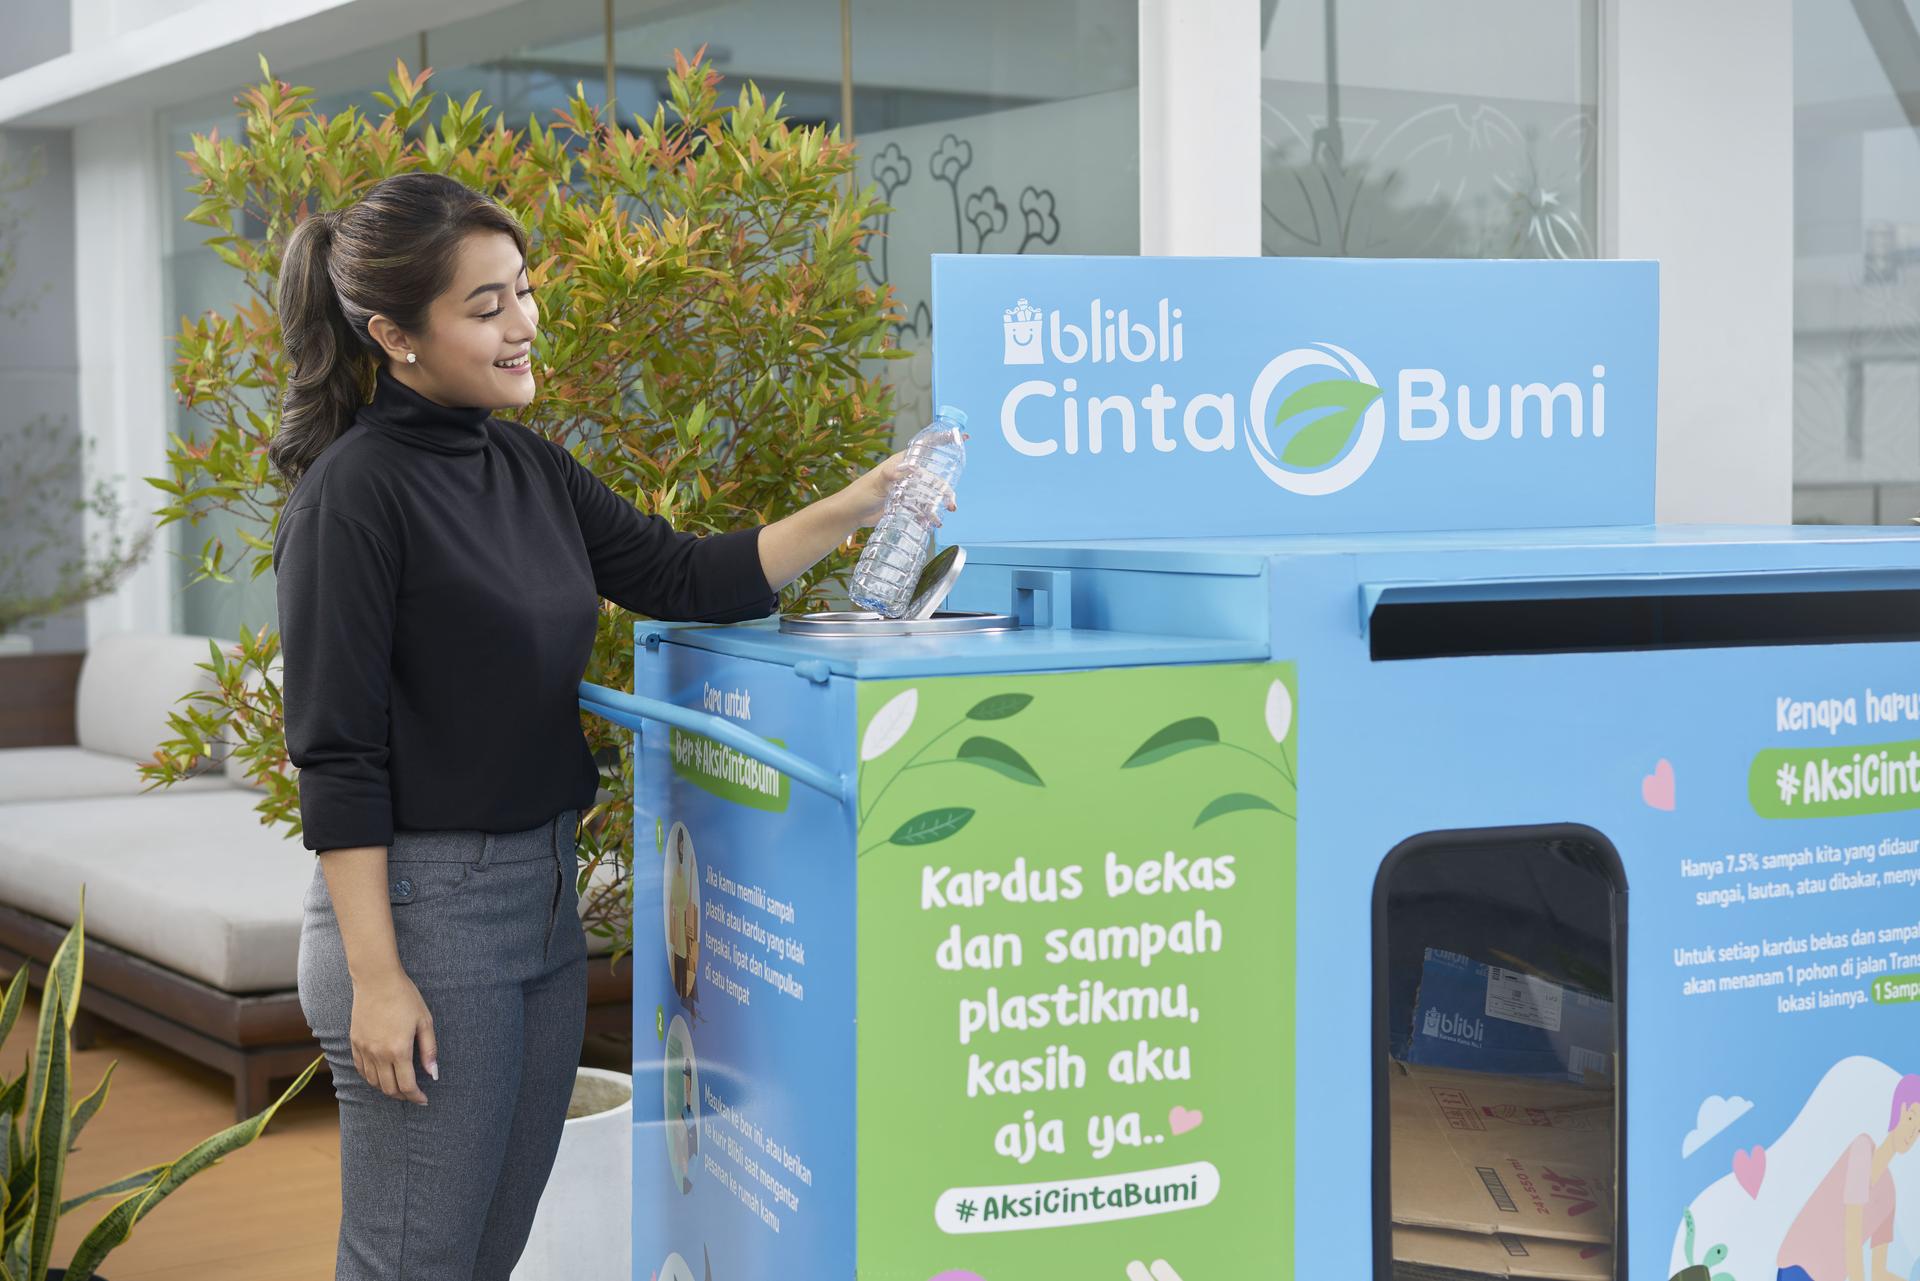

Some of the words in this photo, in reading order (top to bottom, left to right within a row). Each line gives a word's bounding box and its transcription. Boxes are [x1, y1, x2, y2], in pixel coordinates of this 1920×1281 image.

[1050, 297, 1183, 364] blibli
[1000, 378, 1235, 456] Cinta
[1398, 364, 1606, 442] Bumi
[703, 681, 722, 715] Cara
[724, 687, 751, 721] untuk
[1776, 697, 1857, 735] Kenapa
[1865, 688, 1920, 724] haru
[921, 856, 1083, 910] Kardus
[1105, 851, 1236, 898] bekas
[1681, 858, 1724, 880] Hanya
[1726, 852, 1760, 873] 7.5%
[1762, 847, 1813, 871] sampah
[1816, 844, 1841, 863] kita
[1843, 843, 1875, 866] yang
[1878, 837, 1920, 857] didaur
[705, 864, 717, 887] Jika
[718, 870, 736, 896] kamu
[737, 884, 766, 910] memiliki
[767, 897, 795, 925] sampah
[1696, 882, 1745, 908] sungai,
[1747, 881, 1795, 901] lautan,
[1796, 877, 1826, 895] atau
[1829, 869, 1881, 891] dibakar,
[705, 898, 726, 925] plastik
[726, 911, 742, 933] atau
[742, 915, 766, 945] kardus
[767, 931, 784, 961] yang
[786, 937, 805, 966] tidak
[935, 924, 1022, 971] dan
[1045, 909, 1222, 967] sampah
[1674, 944, 1716, 967] Untuk
[1718, 941, 1760, 963] setiap
[1762, 935, 1808, 957] kardus
[1810, 932, 1849, 951] bekas
[1851, 927, 1875, 946] dan
[1878, 920, 1920, 944] sampa
[705, 930, 732, 964] terpakai,
[733, 943, 748, 971] lipat
[749, 952, 762, 978] dan
[764, 959, 803, 1001] kumpulkan
[712, 970, 724, 990] satu
[726, 975, 750, 1007] tempat
[1683, 976, 1716, 996] akan
[1719, 970, 1784, 992] menanam
[1786, 964, 1795, 983] 1
[1796, 962, 1838, 986] pohon
[1841, 957, 1854, 977] di
[1855, 955, 1887, 980] jalan
[959, 979, 1200, 1045] plastikmu,
[1440, 1012, 1484, 1042] blibli
[1777, 993, 1816, 1014] lokasi
[1818, 988, 1869, 1010] lainnya.
[1874, 983, 1882, 1001] 1
[966, 1045, 1086, 1098] kasih
[1108, 1040, 1191, 1084] aku
[740, 1111, 753, 1140] box
[753, 1122, 765, 1153] ini,
[765, 1136, 782, 1163] atau
[783, 1144, 812, 1187] berikan
[994, 1109, 1065, 1164] aja
[1088, 1112, 1164, 1160] ya..
[704, 1153, 729, 1188] pesanan
[738, 1182, 760, 1217] rumah
[760, 1198, 780, 1233] kamu
[712, 1122, 726, 1152] kurir
[727, 1135, 743, 1167] Blibli
[744, 1155, 759, 1181] saat
[759, 1167, 799, 1213] mengantar
[955, 1174, 1198, 1223] #AksiCintaBumi
